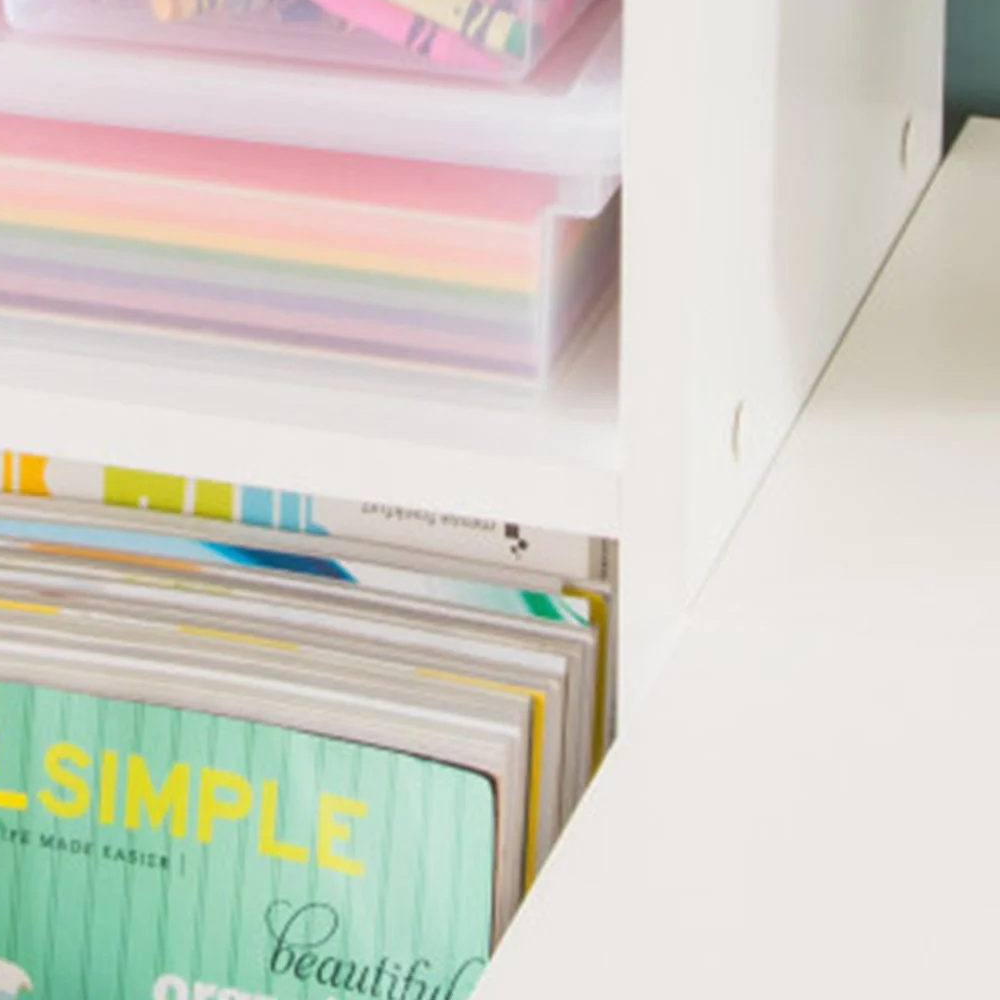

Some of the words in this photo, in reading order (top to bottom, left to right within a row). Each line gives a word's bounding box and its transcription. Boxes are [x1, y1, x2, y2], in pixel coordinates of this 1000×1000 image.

[36, 741, 368, 877] SIMPLE
[39, 833, 95, 855] MADE
[102, 845, 170, 871] EASIER
